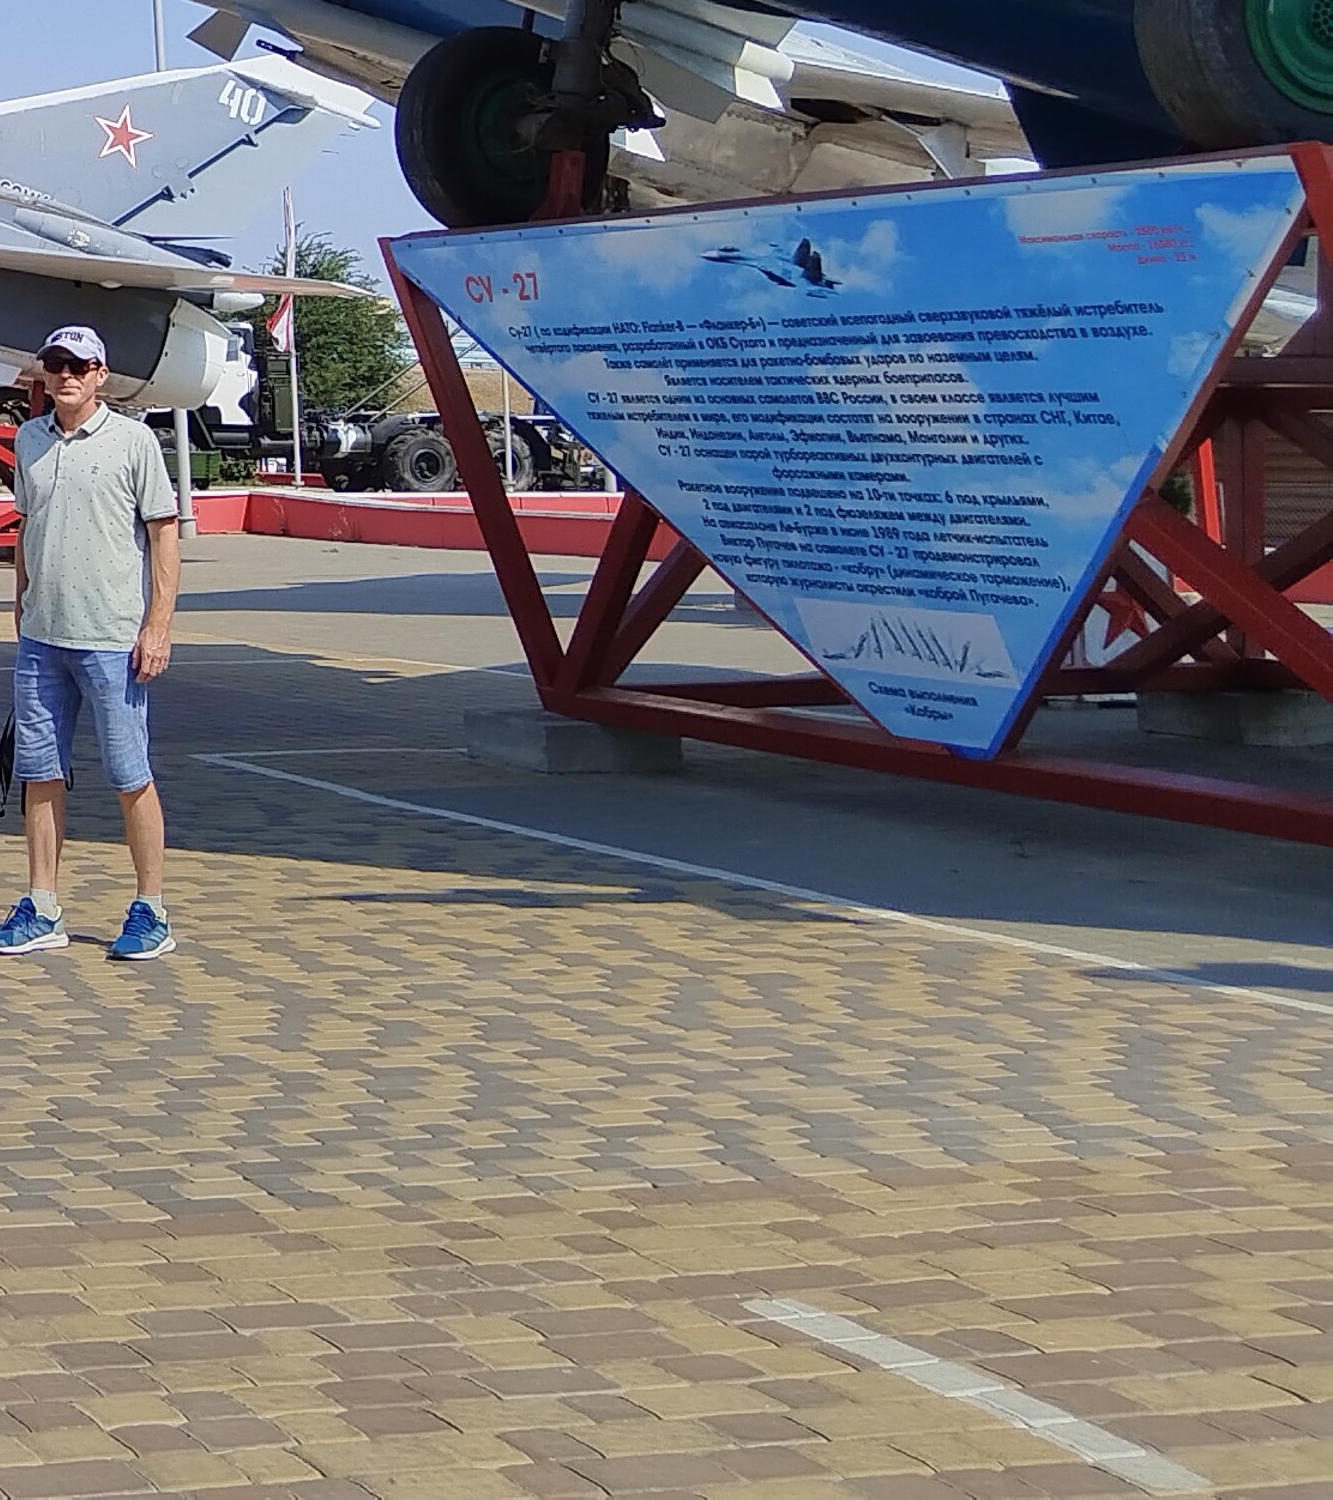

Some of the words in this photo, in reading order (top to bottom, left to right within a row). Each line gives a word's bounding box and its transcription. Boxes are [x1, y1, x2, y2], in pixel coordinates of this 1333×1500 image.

[218, 79, 267, 127] 40
[464, 275, 493, 303] СУ
[512, 272, 539, 301] 27
